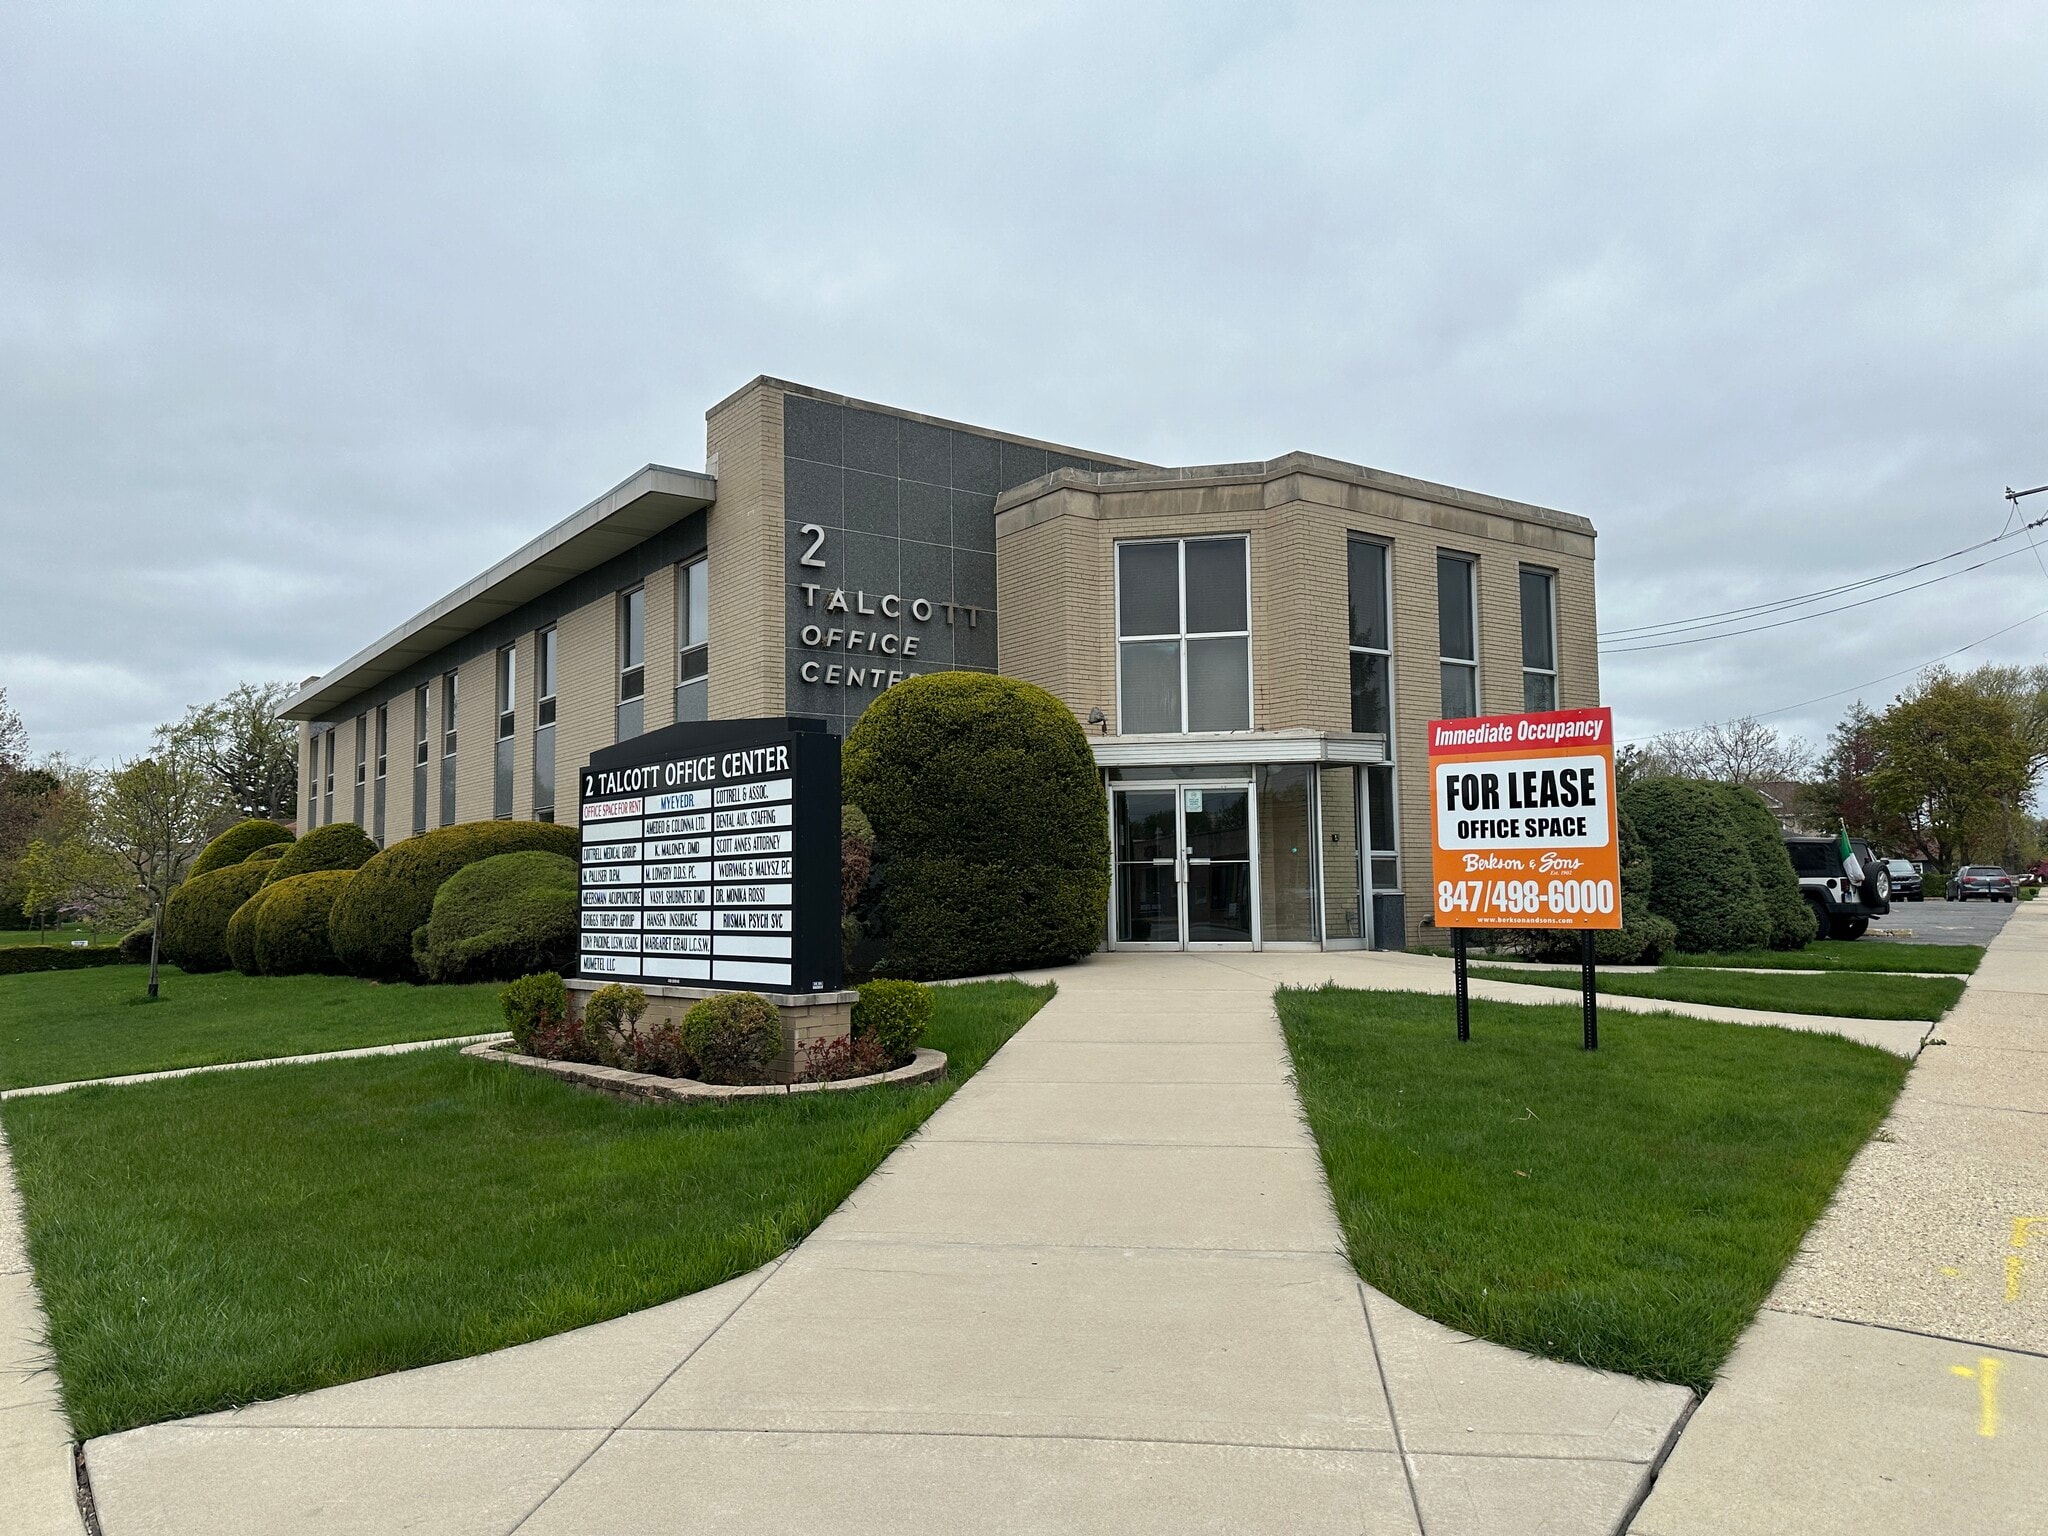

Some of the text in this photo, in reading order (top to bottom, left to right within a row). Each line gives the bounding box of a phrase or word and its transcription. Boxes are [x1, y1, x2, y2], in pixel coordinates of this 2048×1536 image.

[800, 523, 826, 568] 2
[801, 583, 983, 628] TALCOTT
[801, 625, 920, 656] OFFICE
[800, 661, 922, 690] CENTE
[1434, 718, 1603, 746] Immediate Occupancy
[586, 745, 790, 797] 2 TALCOTT OFFICE CENTER
[716, 784, 769, 804] COTTRELL & ASSOC.
[1446, 767, 1596, 811] FOR LEASE
[584, 800, 641, 819] OFFICE SPACE FOR RENT
[716, 812, 735, 829] DENTAL
[751, 809, 776, 825] STAFFING
[646, 816, 706, 835] AMEDEO & COLONNA LTD.
[1457, 816, 1587, 840] OFFICE SPACE
[584, 845, 637, 861] COTTRELL MEDICAL GROUP
[654, 844, 660, 857] K.
[687, 841, 700, 855] DMD
[716, 834, 781, 853] SCOTT ANNES ATTORNEY
[718, 860, 792, 878] WORWAG & MALYSZ P.C.
[1462, 851, 1584, 873] Berkson & Sons
[589, 870, 608, 883] PALLISER
[652, 866, 672, 880] LOWERY
[583, 890, 641, 905] MEERSMAN ACUPUNCTURE
[650, 890, 664, 904] VASYL
[693, 889, 705, 904] DMD
[715, 887, 765, 903] DR. MONIKA ROSSI
[1438, 879, 1614, 914] 847/498-6000
[584, 913, 635, 927] BRIGGS THERAPY GROUP
[646, 913, 698, 927] HANSEN INSURANCE
[748, 913, 768, 928] PSYCH
[771, 913, 783, 929] SVC
[1477, 916, 1573, 924] www.berksonandsons.com
[645, 936, 672, 950] MARGARET
[673, 937, 688, 952] GRAU
[606, 958, 616, 972] LLC
